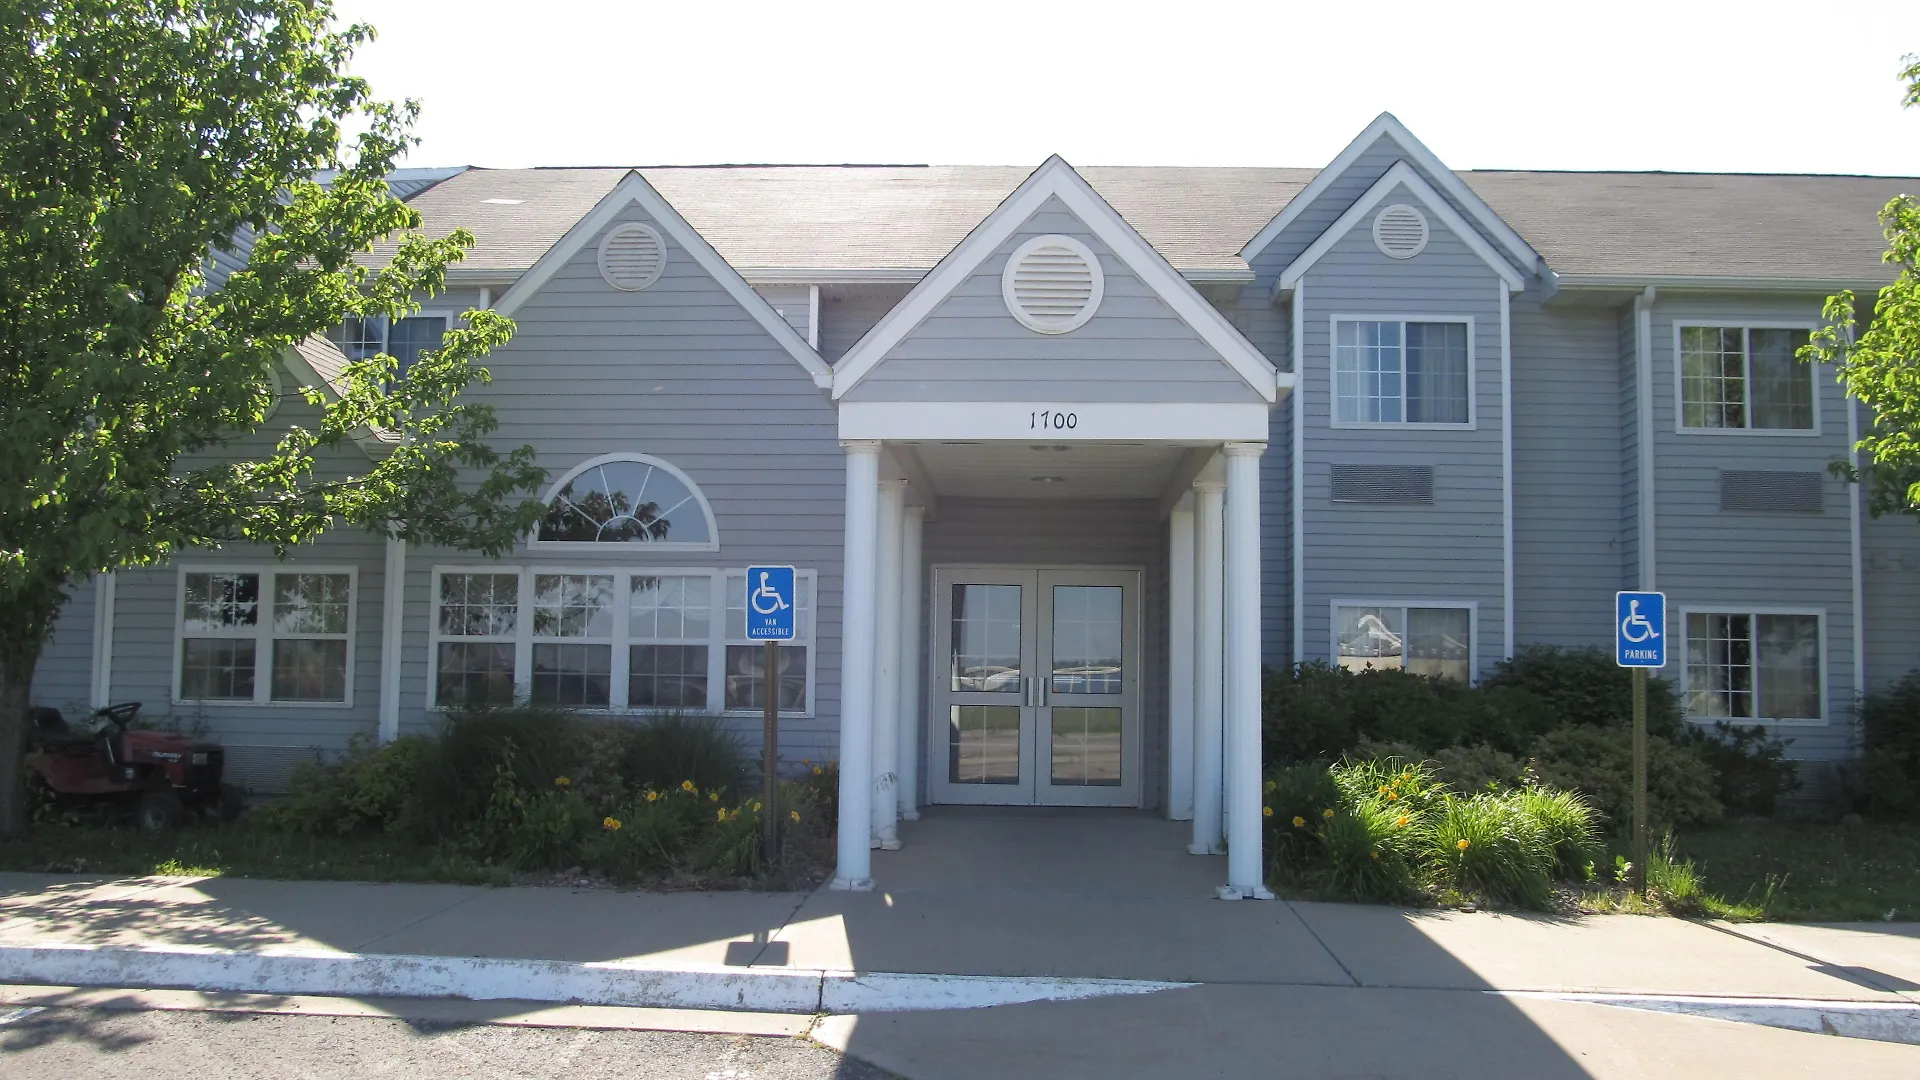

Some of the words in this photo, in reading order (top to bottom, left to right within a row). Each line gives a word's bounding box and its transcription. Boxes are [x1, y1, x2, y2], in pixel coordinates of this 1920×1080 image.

[1031, 411, 1077, 429] 1700
[764, 618, 777, 626] VAN
[752, 627, 789, 636] ACCESSIBLE
[1624, 649, 1658, 660] PARKING
